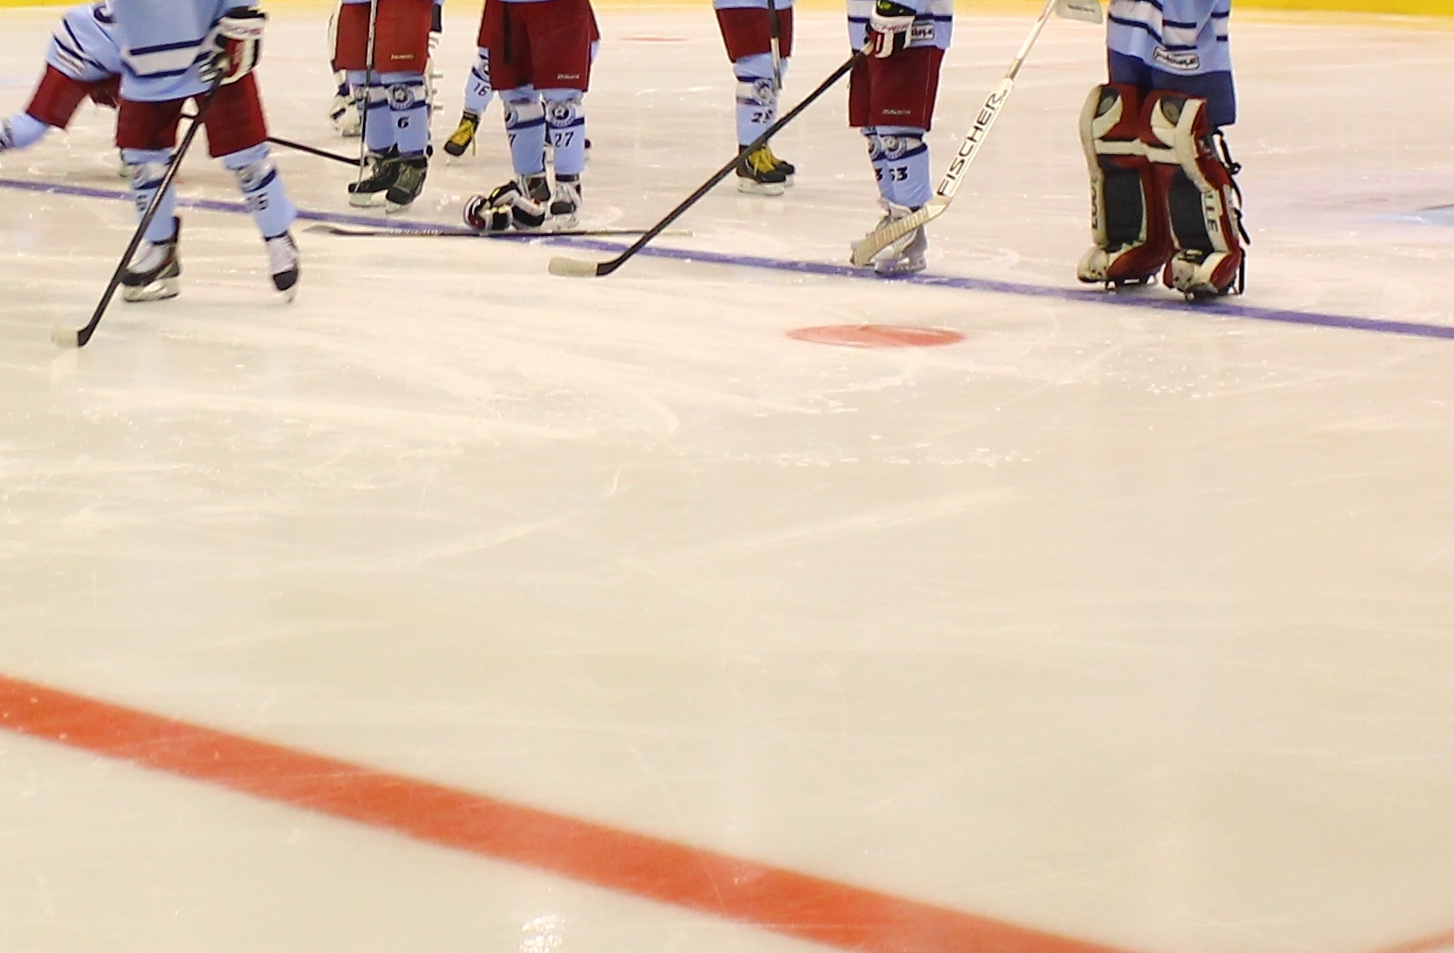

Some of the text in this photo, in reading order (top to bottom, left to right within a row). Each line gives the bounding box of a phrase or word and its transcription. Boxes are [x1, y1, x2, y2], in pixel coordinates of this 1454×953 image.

[473, 81, 490, 97] 16
[397, 116, 410, 129] 6
[554, 131, 575, 147] 27
[936, 89, 1007, 197] FISCHER
